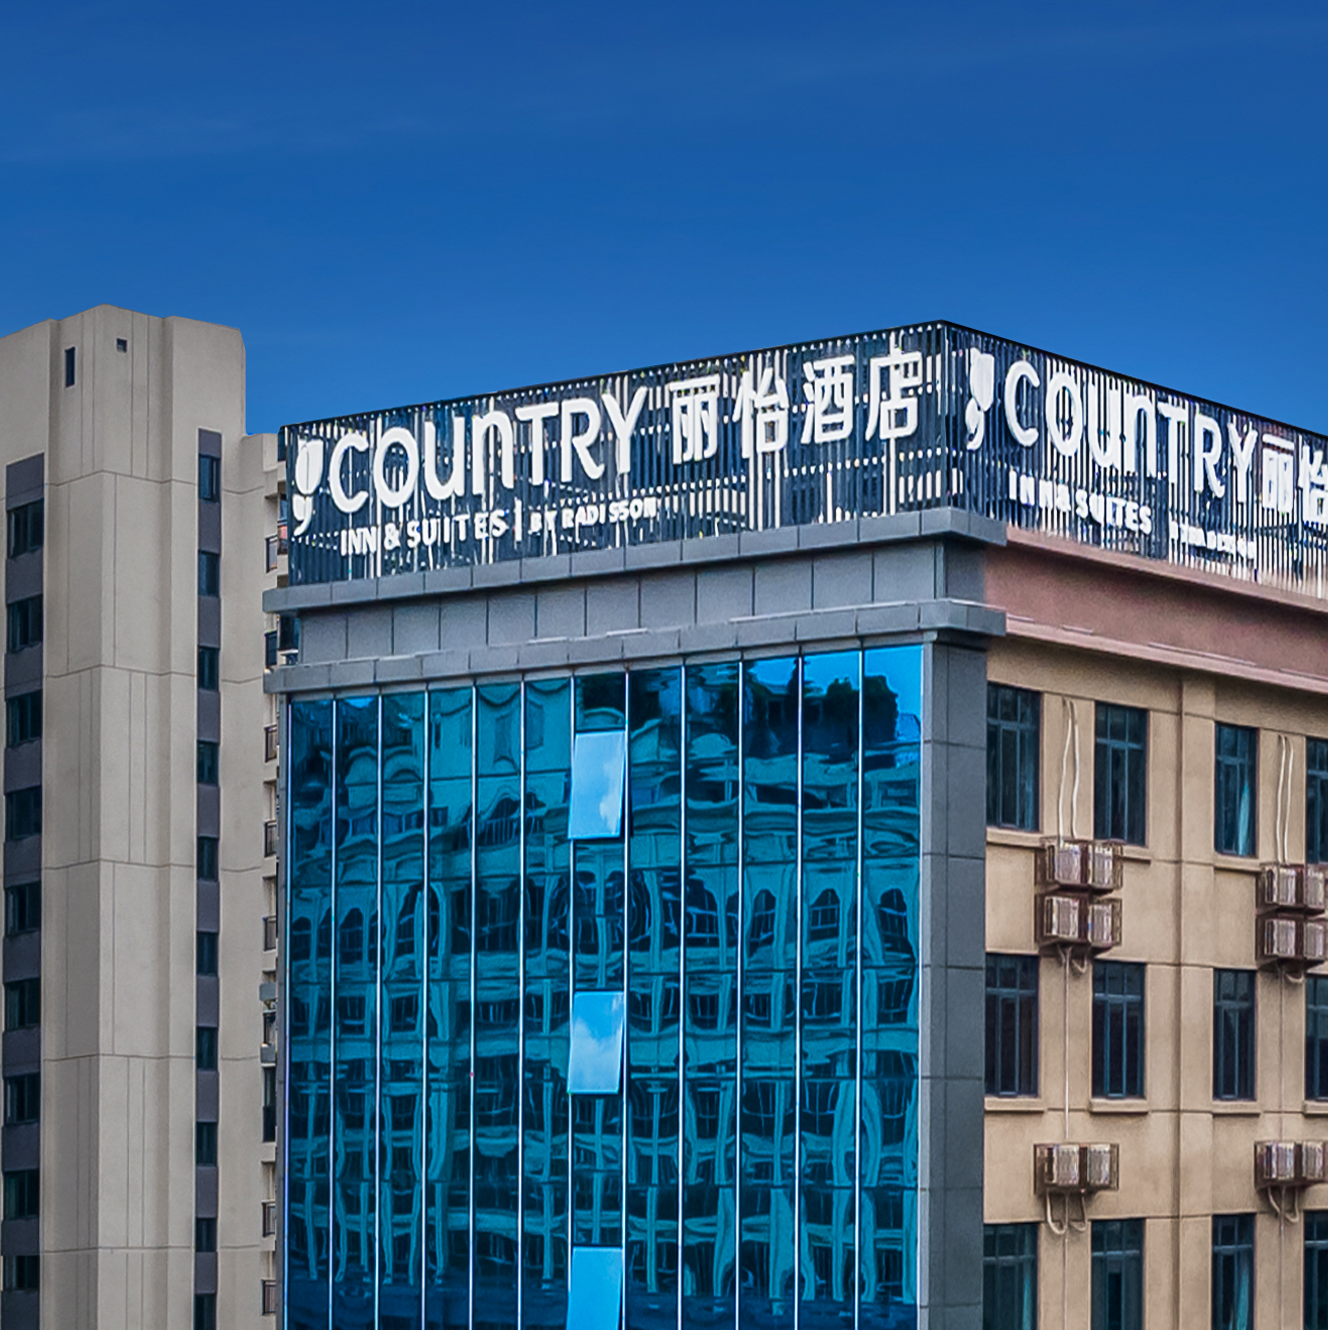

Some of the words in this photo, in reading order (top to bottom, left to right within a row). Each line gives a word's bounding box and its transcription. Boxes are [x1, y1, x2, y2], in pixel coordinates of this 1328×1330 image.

[669, 346, 922, 465] 丽怡酒店
[340, 526, 377, 557] INN
[384, 523, 401, 551] &
[407, 509, 510, 548] SUITES
[562, 496, 659, 529] RADISSON
[1075, 488, 1152, 535] SUITES
